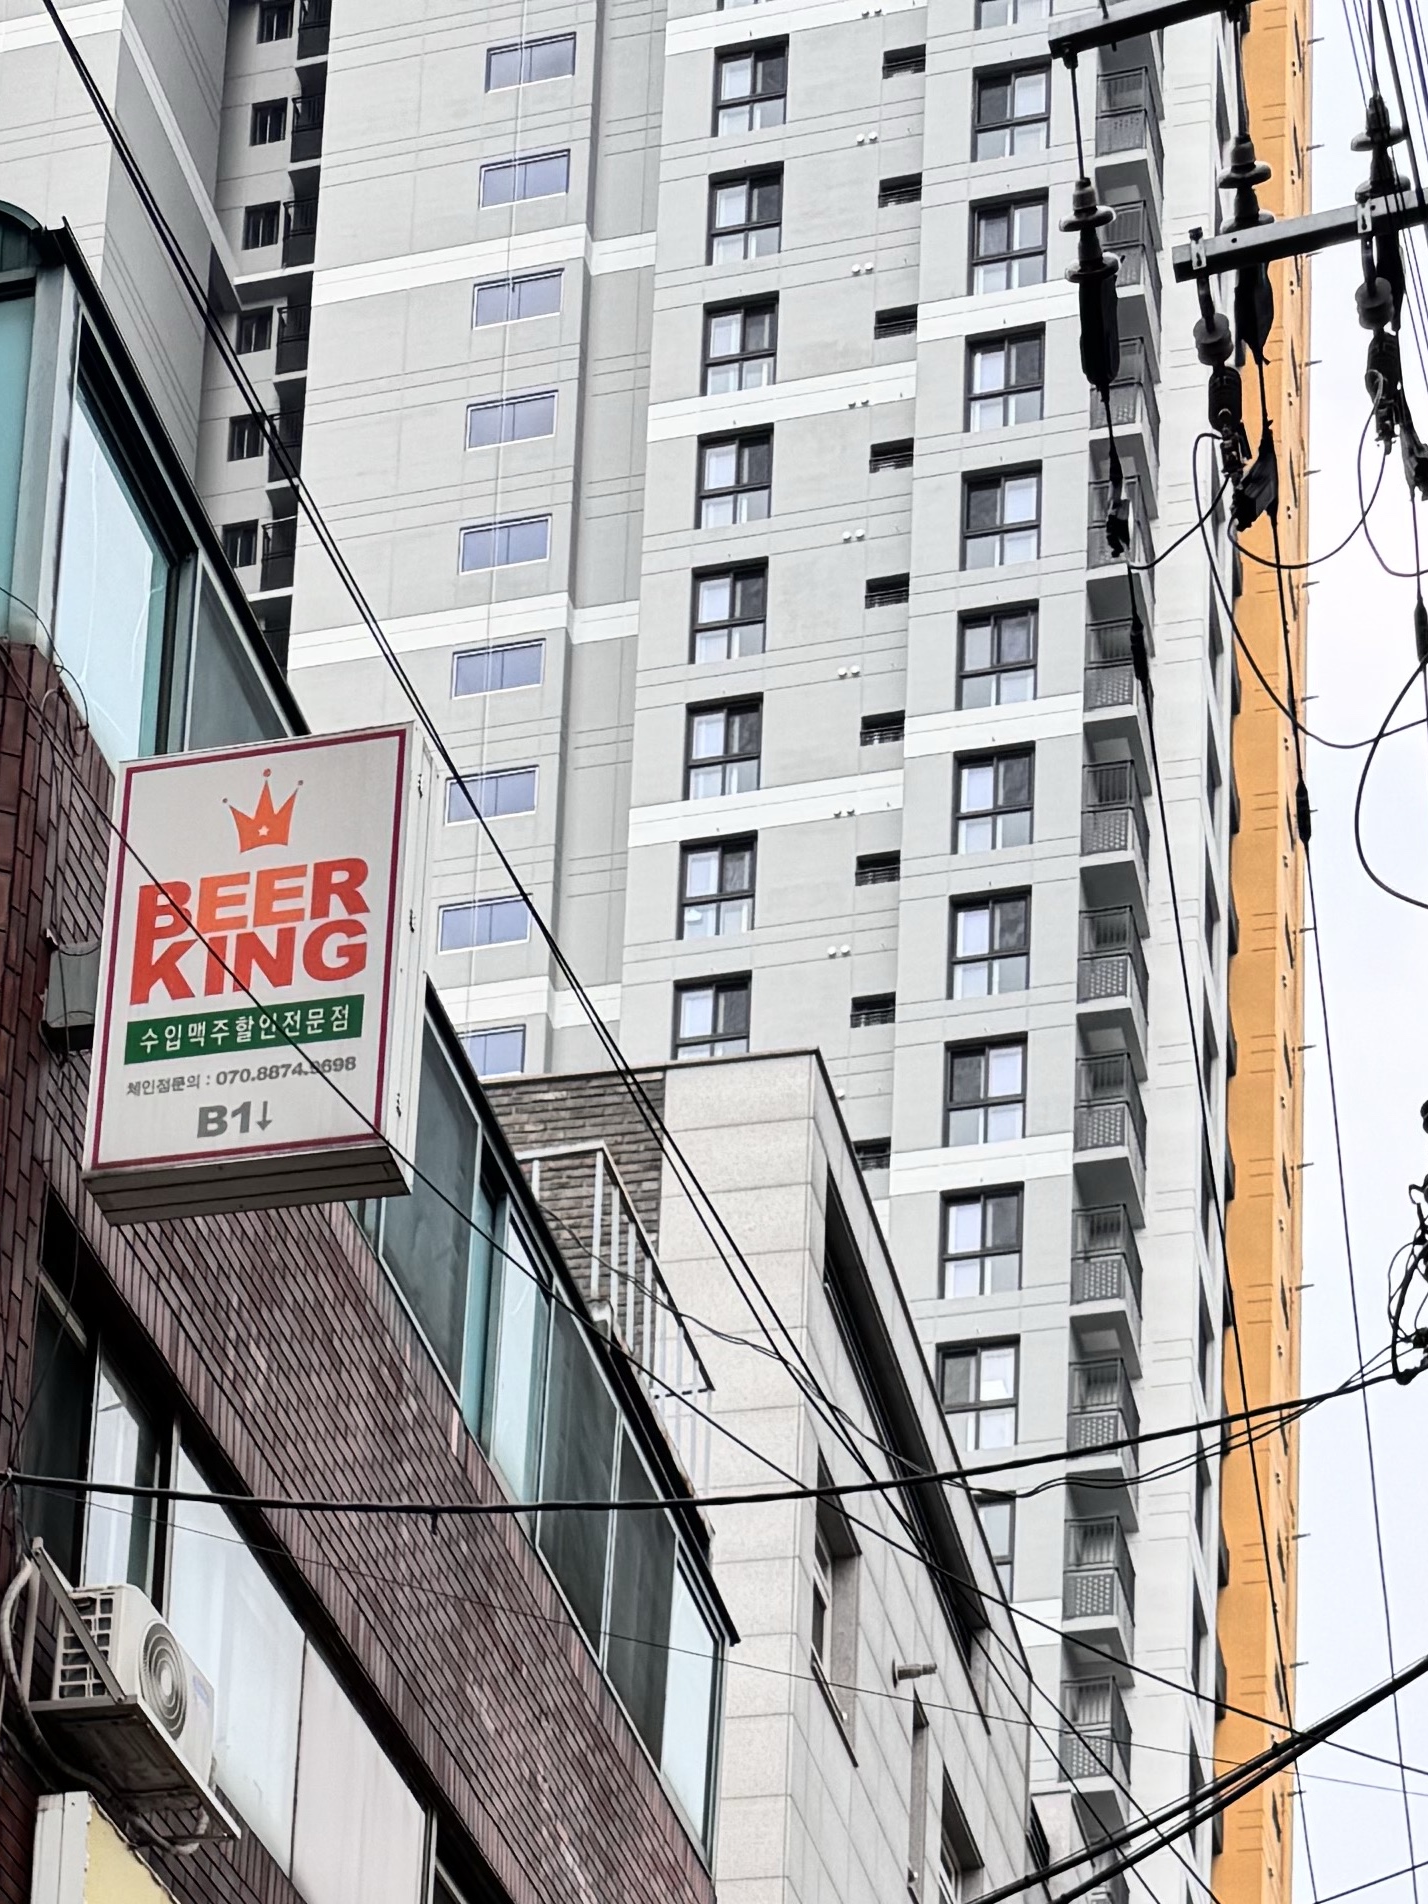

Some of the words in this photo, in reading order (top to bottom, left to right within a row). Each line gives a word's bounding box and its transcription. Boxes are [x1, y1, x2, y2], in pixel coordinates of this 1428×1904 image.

[136, 858, 371, 940] BEER
[130, 919, 368, 1006] KING
[140, 1004, 350, 1054] 수입맥주할인전문점
[197, 1101, 252, 1138] B1
